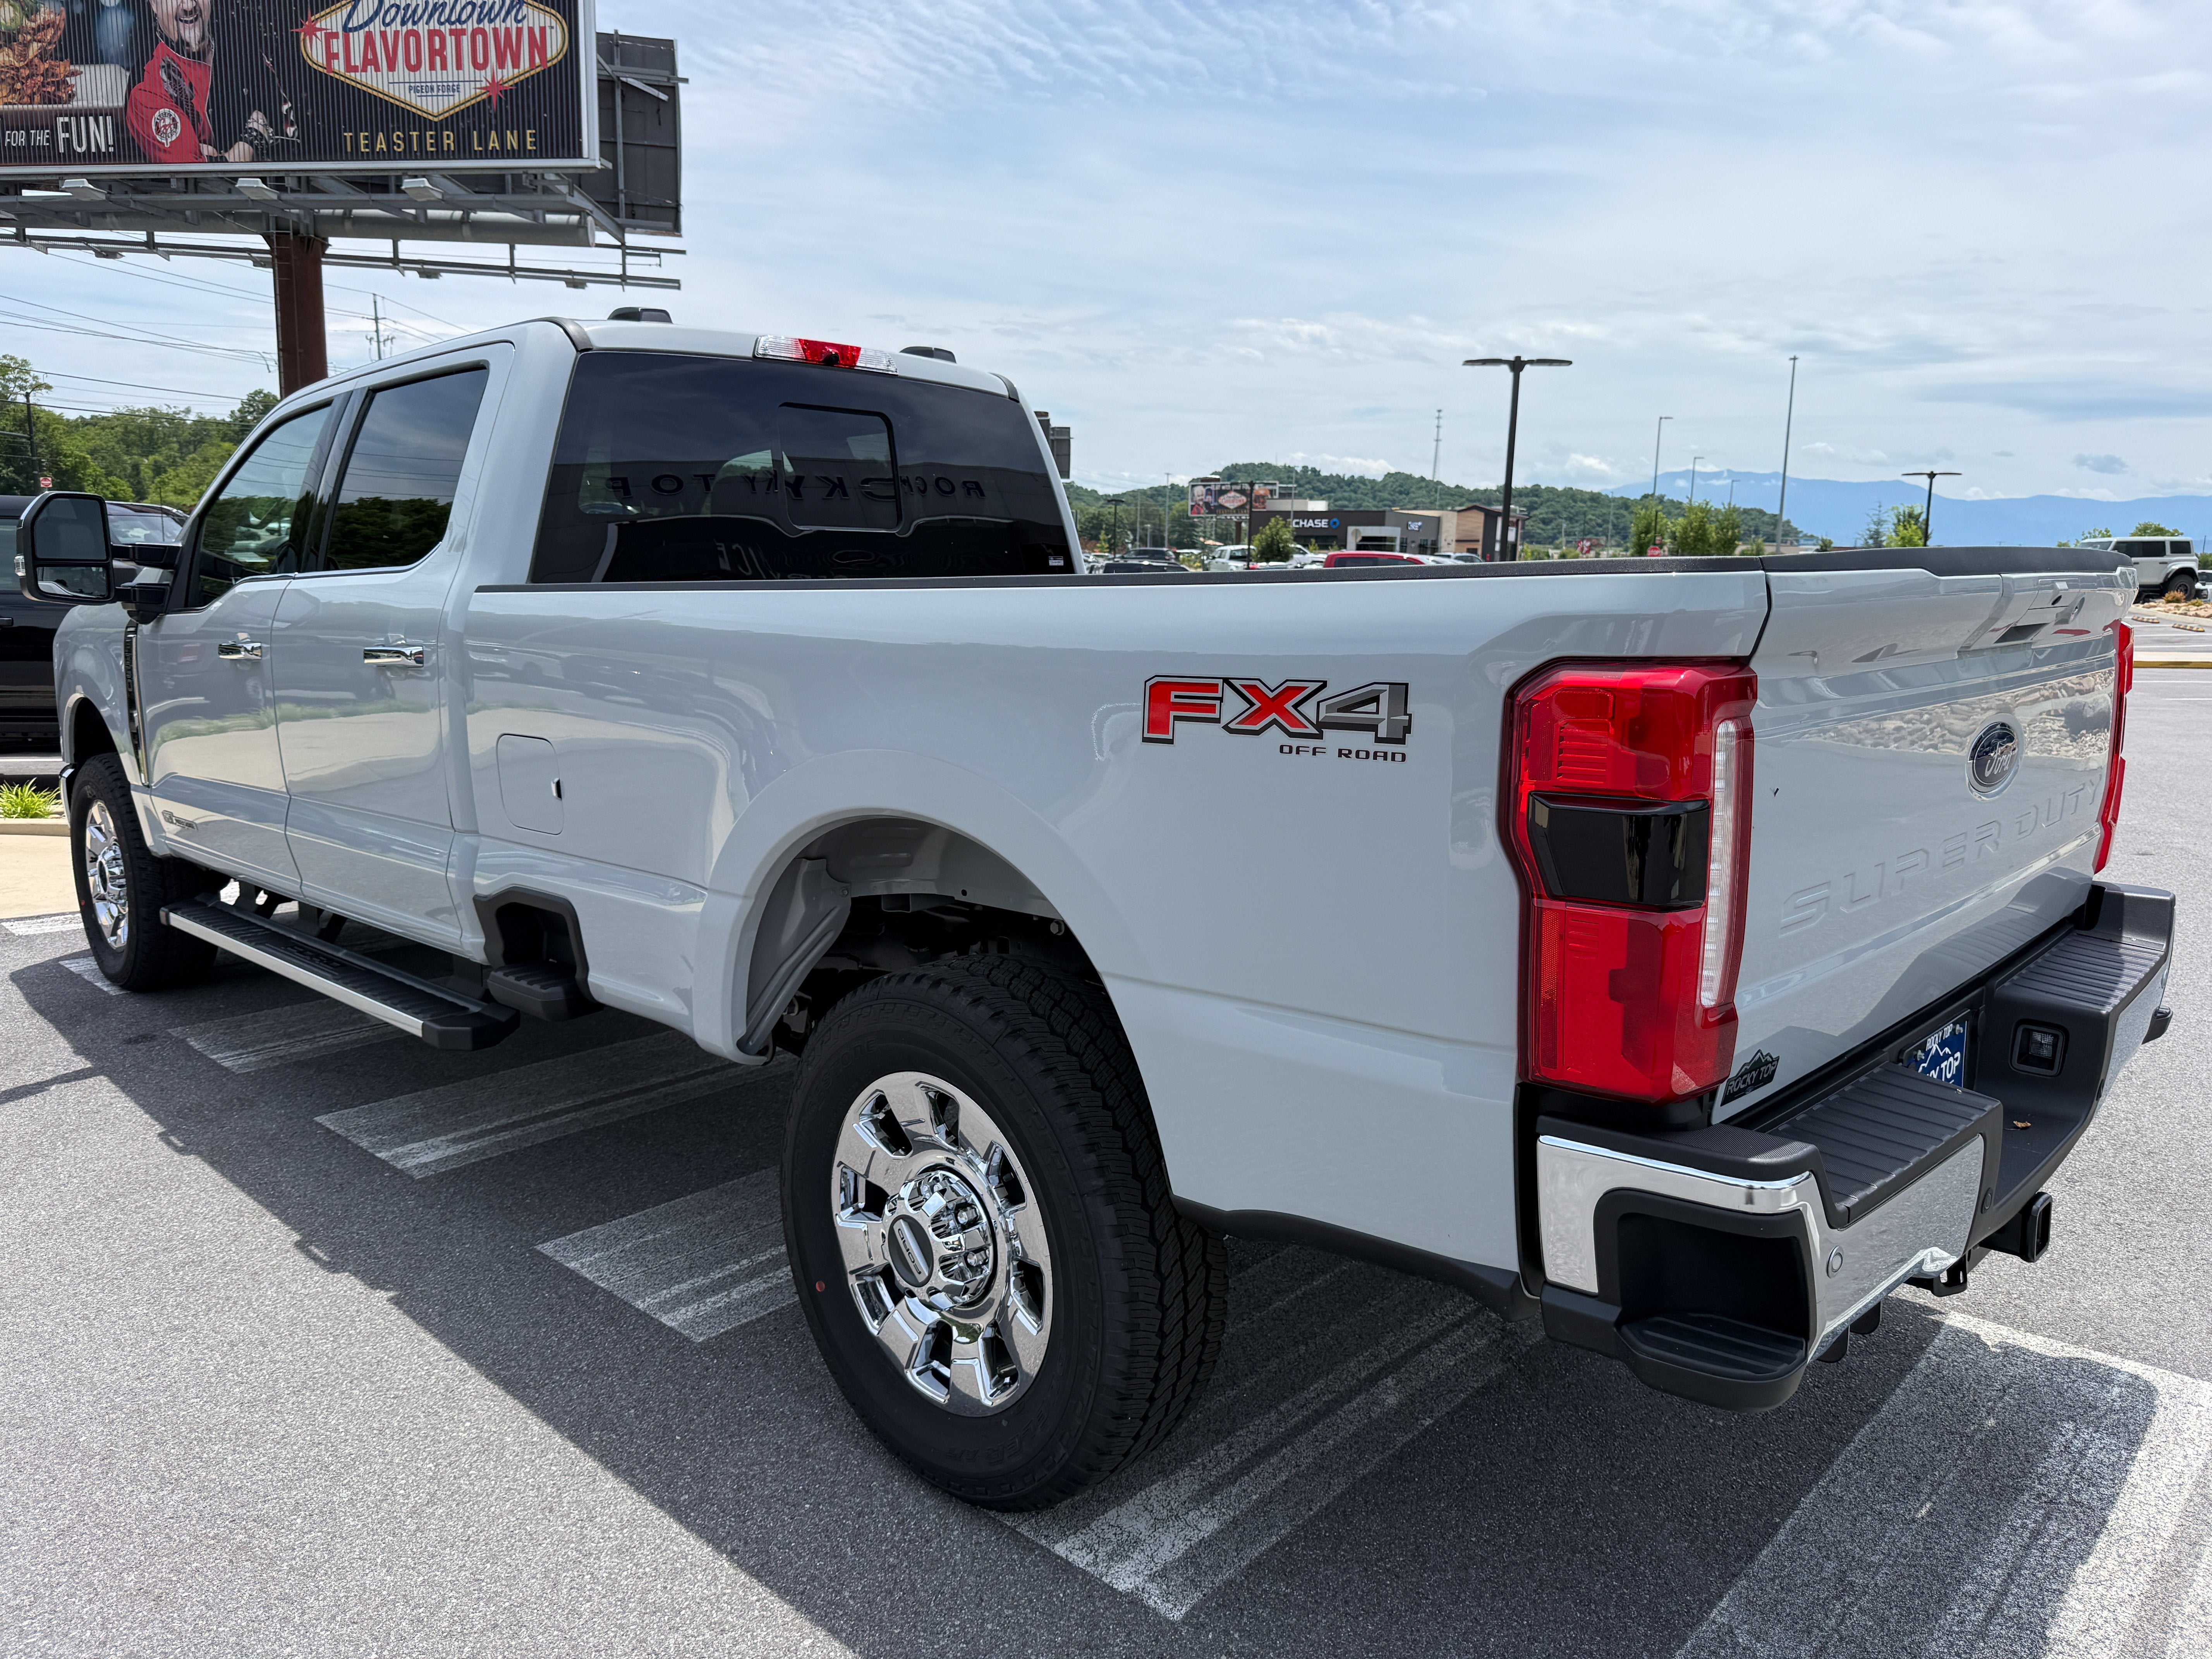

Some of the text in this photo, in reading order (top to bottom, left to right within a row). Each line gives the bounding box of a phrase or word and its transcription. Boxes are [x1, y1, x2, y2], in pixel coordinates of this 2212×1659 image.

[324, 26, 548, 74] FLAVORTOWN
[409, 84, 460, 94] PIGEON FORGE
[5, 115, 114, 153] FOR THE FUN!
[343, 129, 537, 153] TEASTER LANE
[1292, 519, 1329, 528] CHASE
[1142, 675, 1412, 745] FX4
[1279, 744, 1407, 763] OFF ROAD
[1985, 738, 2013, 777] Ford
[1778, 774, 2103, 938] SUPER DUTY
[1925, 1023, 1953, 1051] ROCKY TOP
[1726, 1061, 1778, 1096] ROCKY TOP
[1941, 1051, 1961, 1081] TOP
[898, 1228, 922, 1275] FORD
